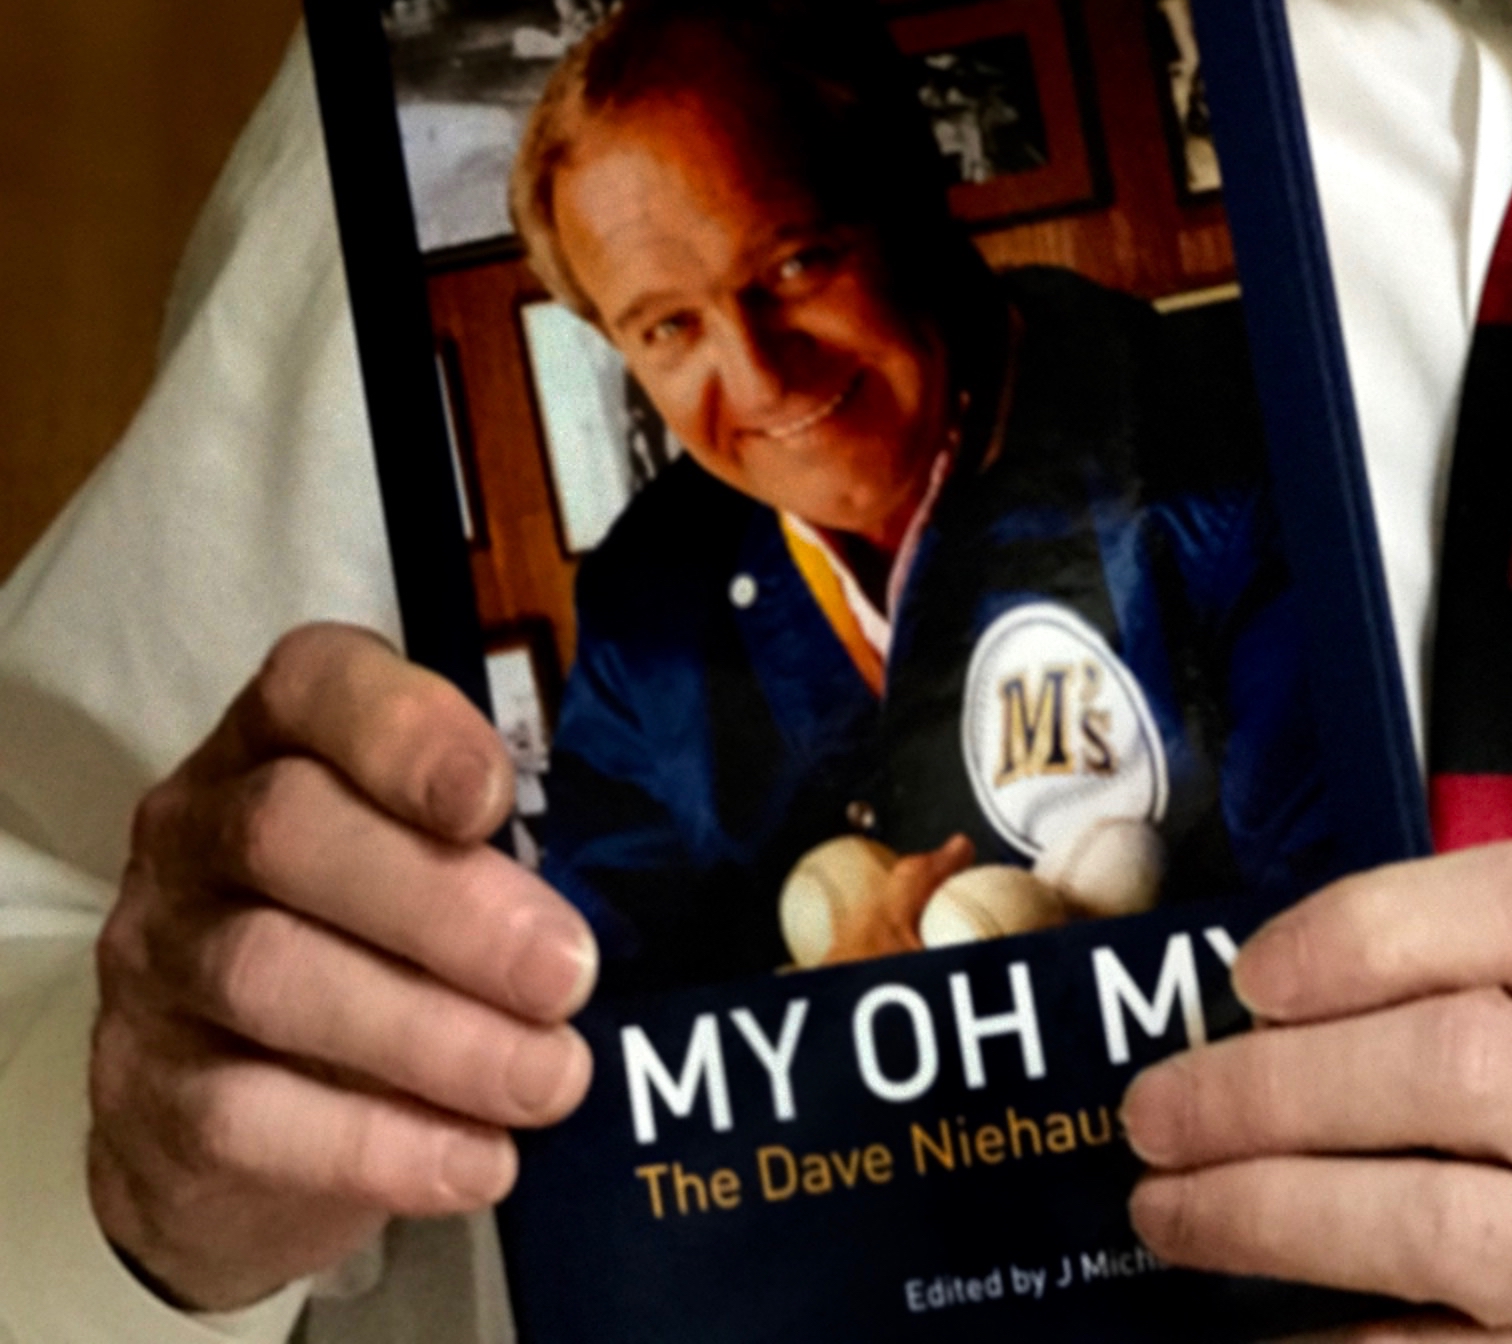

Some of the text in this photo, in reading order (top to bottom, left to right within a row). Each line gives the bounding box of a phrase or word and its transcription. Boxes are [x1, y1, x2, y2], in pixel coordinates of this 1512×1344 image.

[993, 660, 1119, 788] M's
[620, 997, 808, 1145] MY
[852, 962, 1046, 1103] OH
[634, 1161, 742, 1219] The
[755, 1142, 893, 1202] Dave
[904, 1265, 1004, 1313] Edited
[1010, 1263, 1047, 1299] by
[1055, 1254, 1073, 1288] J
